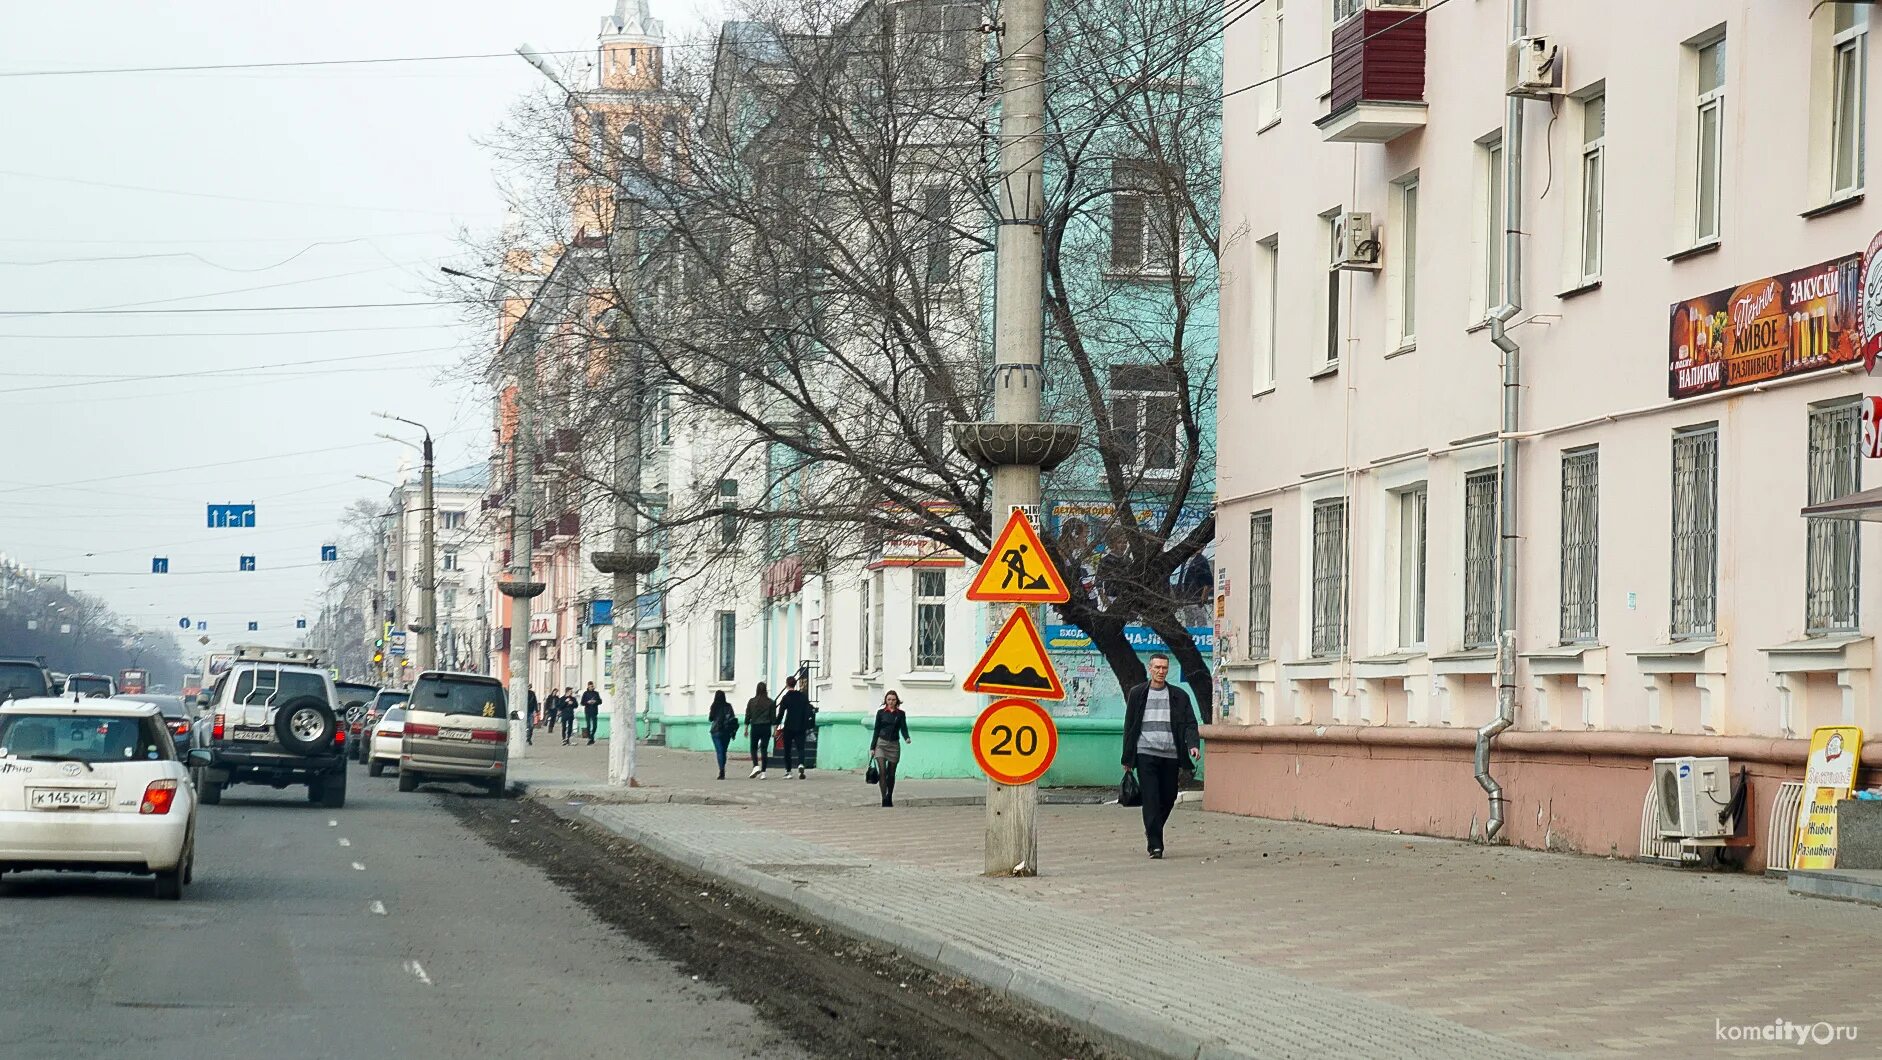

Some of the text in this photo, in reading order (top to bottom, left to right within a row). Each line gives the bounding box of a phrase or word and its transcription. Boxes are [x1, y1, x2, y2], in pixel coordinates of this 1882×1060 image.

[1789, 271, 1839, 305] ЗАКУСКИ
[1734, 281, 1775, 336] Пенное
[1732, 319, 1778, 356] ЖИВОЕ
[1678, 361, 1720, 389] НАПИТКИ
[1731, 354, 1779, 379] РАЗЛИВНОЕ
[1059, 628, 1085, 639] ВХОД
[990, 724, 1038, 757] 20
[1807, 821, 1833, 836] Живое
[1796, 842, 1837, 857] Разливное
